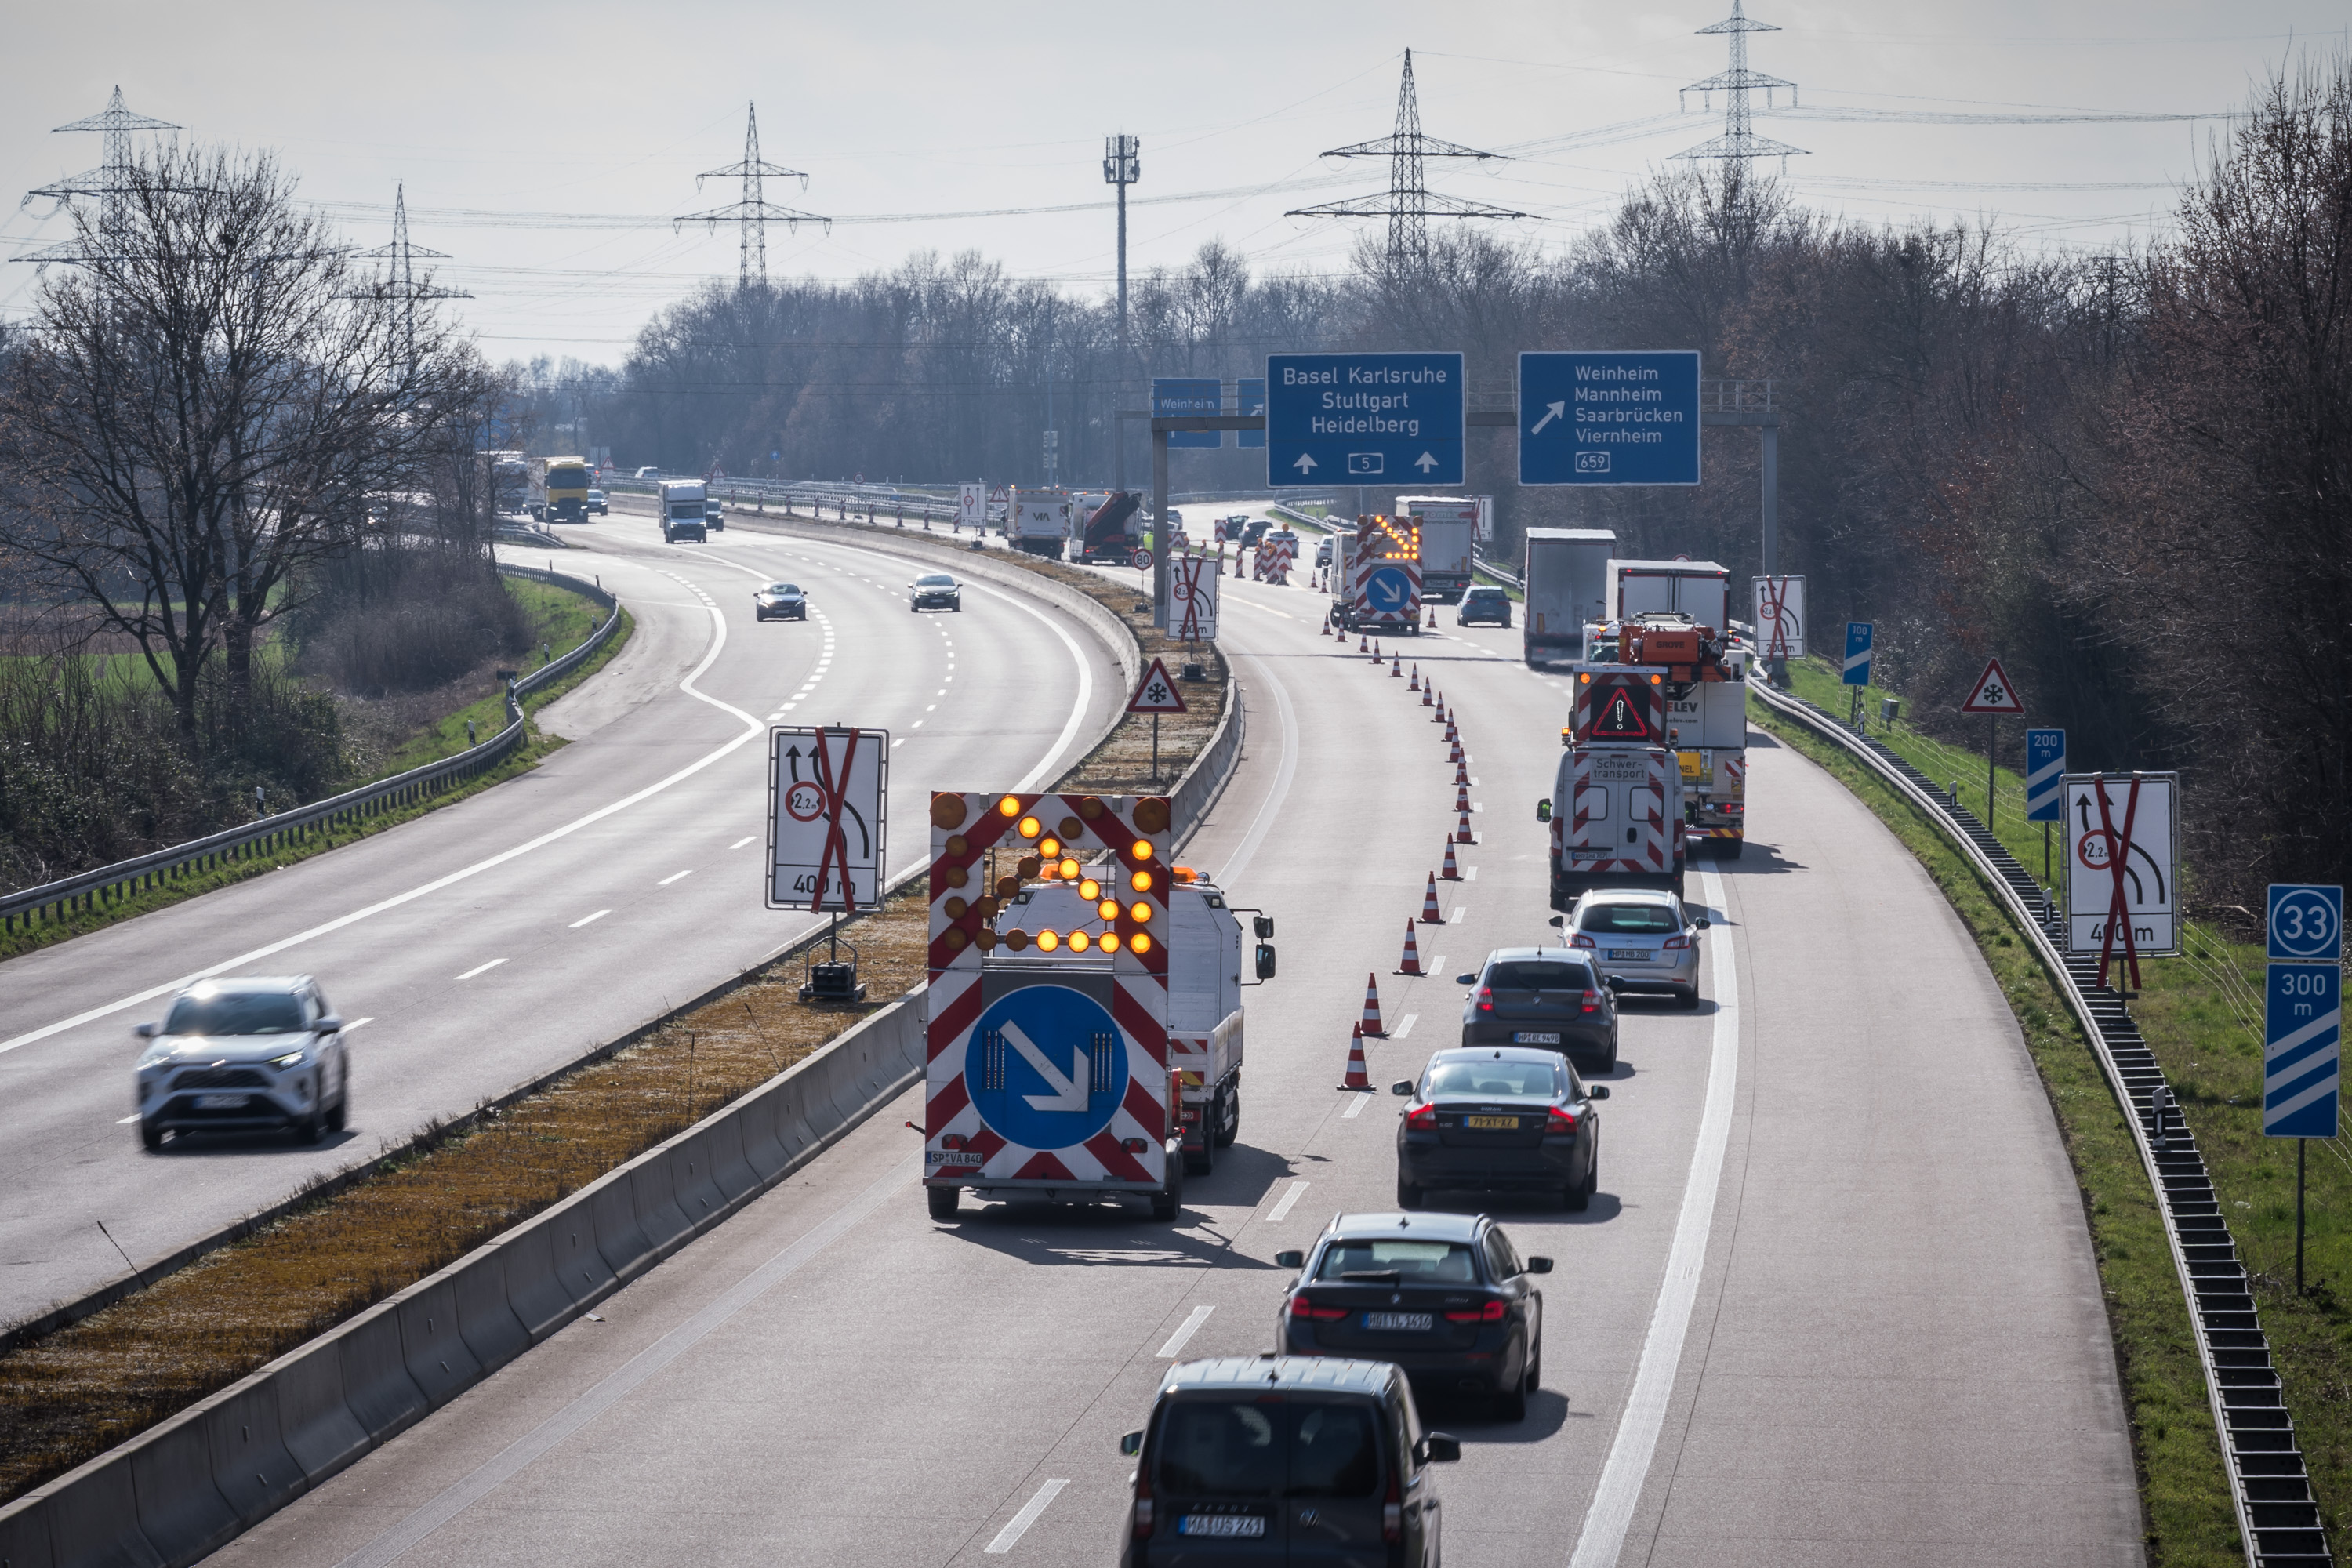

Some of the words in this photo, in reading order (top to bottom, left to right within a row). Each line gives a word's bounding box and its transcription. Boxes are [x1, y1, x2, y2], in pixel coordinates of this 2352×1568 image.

[1283, 367, 1338, 385] Basel
[1349, 366, 1446, 383] Karlsruhe
[1575, 365, 1658, 381] Weinheim
[1575, 387, 1662, 401] Mannheim
[1161, 398, 1214, 409] Weinheim
[1322, 392, 1409, 412] Stuttgart
[1576, 407, 1683, 422] Saarbrücken
[1312, 416, 1419, 436] Heidelberg
[1576, 428, 1662, 443] Viernheim
[1362, 457, 1370, 470] 5
[1581, 456, 1605, 468] 659
[1033, 512, 1051, 521] VIA
[1136, 554, 1149, 564] 80
[1853, 626, 1867, 635] 100
[1667, 702, 1698, 713] ELEV
[2034, 735, 2058, 746] 200
[2041, 749, 2051, 757] m
[1596, 758, 1642, 768] Schwer-
[1594, 769, 1645, 780] transport
[2283, 905, 2327, 940] 33
[2135, 927, 2153, 941] m
[2281, 973, 2326, 996] 300
[2294, 1003, 2312, 1016] m
[932, 1153, 945, 1163] SP
[950, 1154, 962, 1163] VA
[964, 1154, 982, 1163] 840
